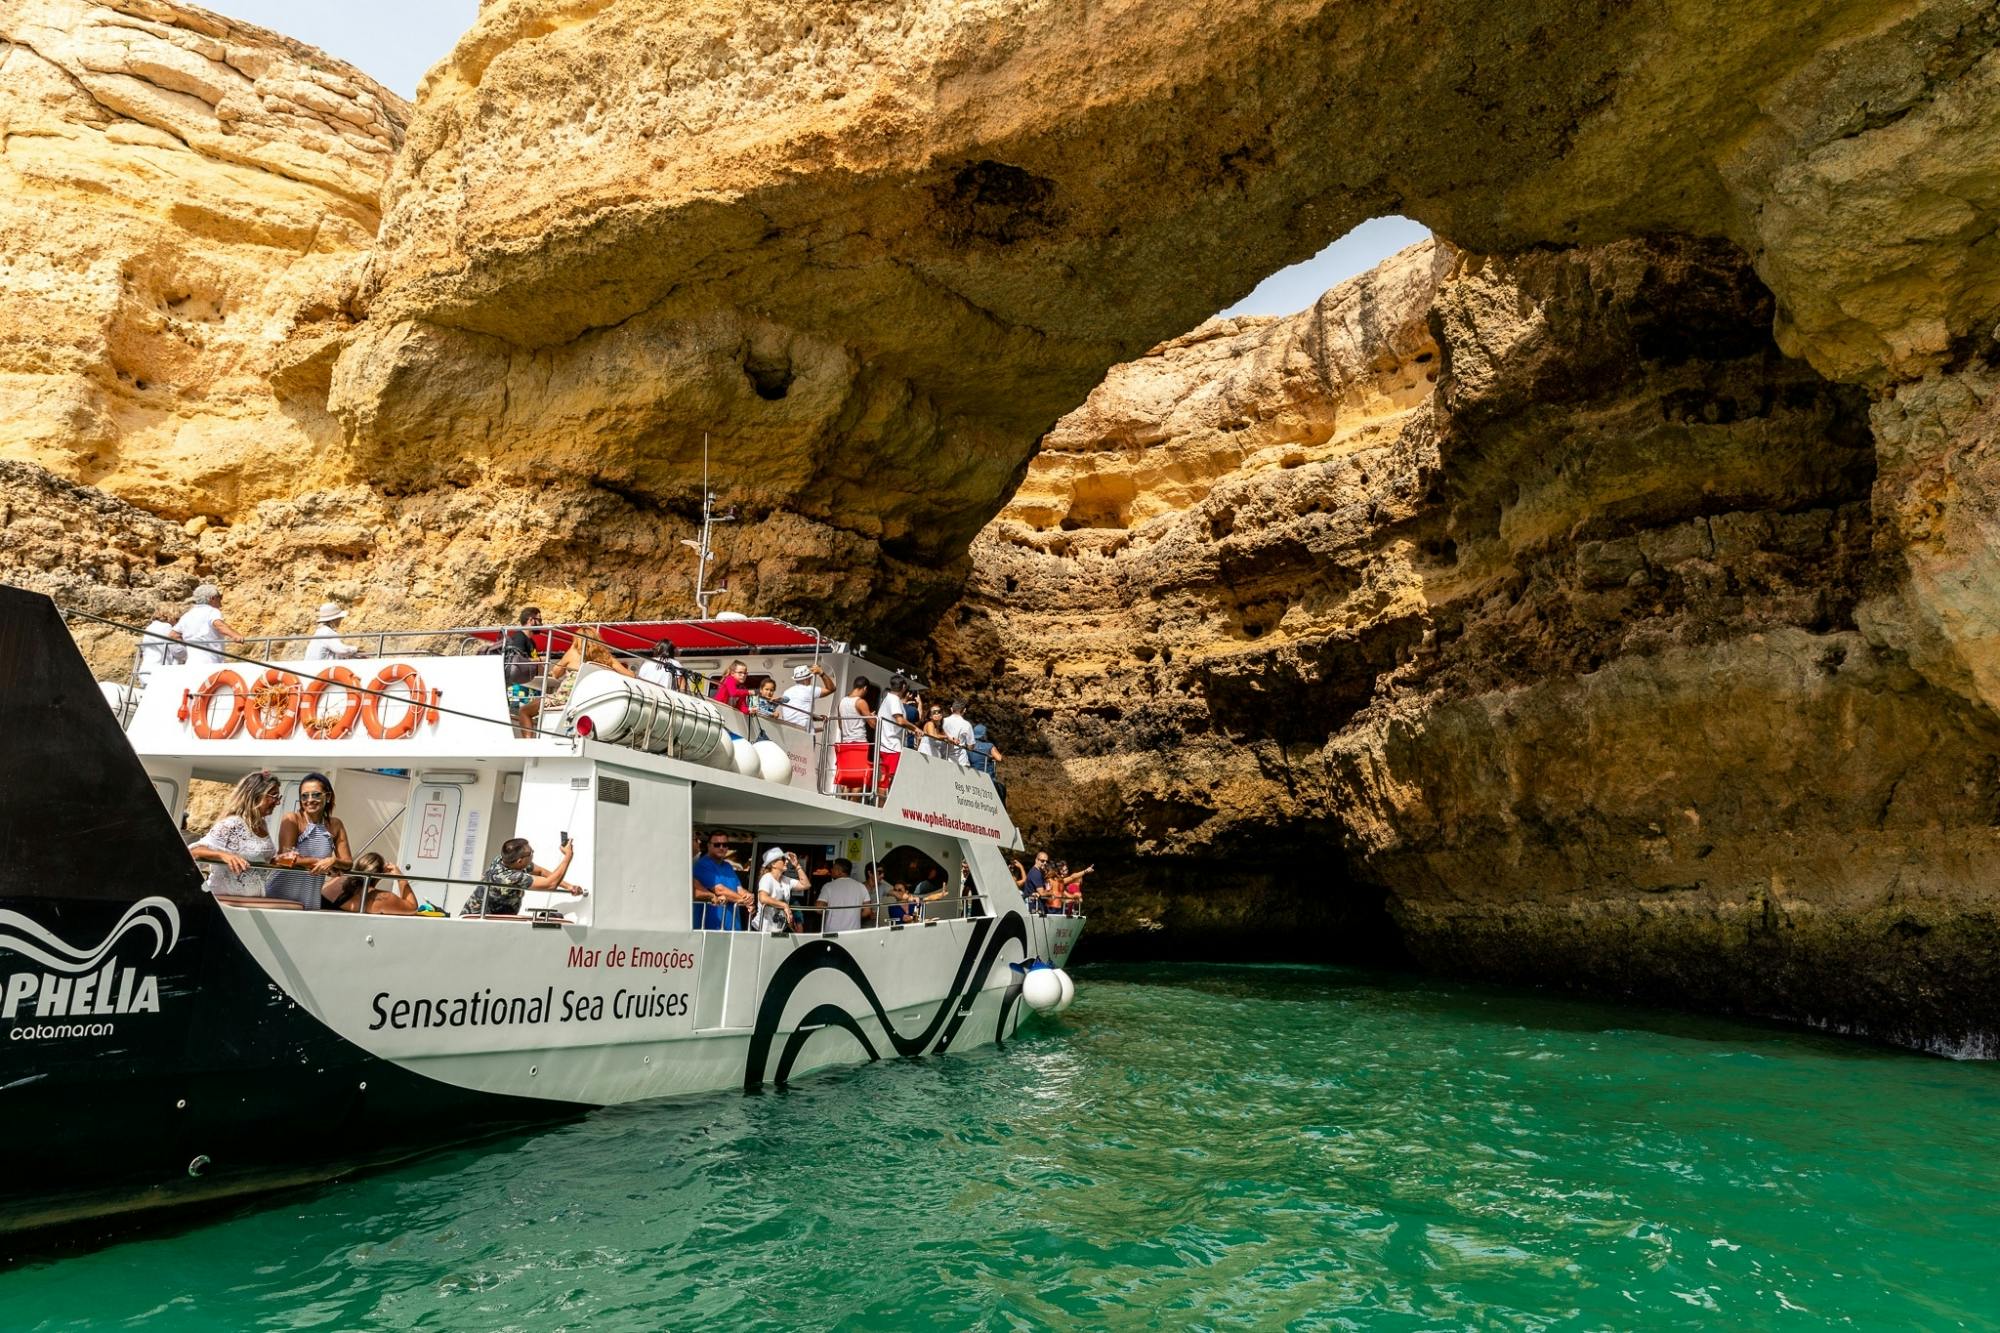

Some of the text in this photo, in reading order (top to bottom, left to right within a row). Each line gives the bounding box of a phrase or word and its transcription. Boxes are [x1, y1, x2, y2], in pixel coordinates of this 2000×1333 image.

[956, 796, 974, 808] Turismo
[980, 802, 998, 816] Portugal
[901, 808, 1000, 839] www.opheliacatamaran.com
[568, 945, 694, 973] Mar de Emoções
[0, 955, 160, 1018] PHELIA
[368, 986, 688, 1030] Sensational Sea Cruises
[10, 1023, 114, 1040] catamaran
